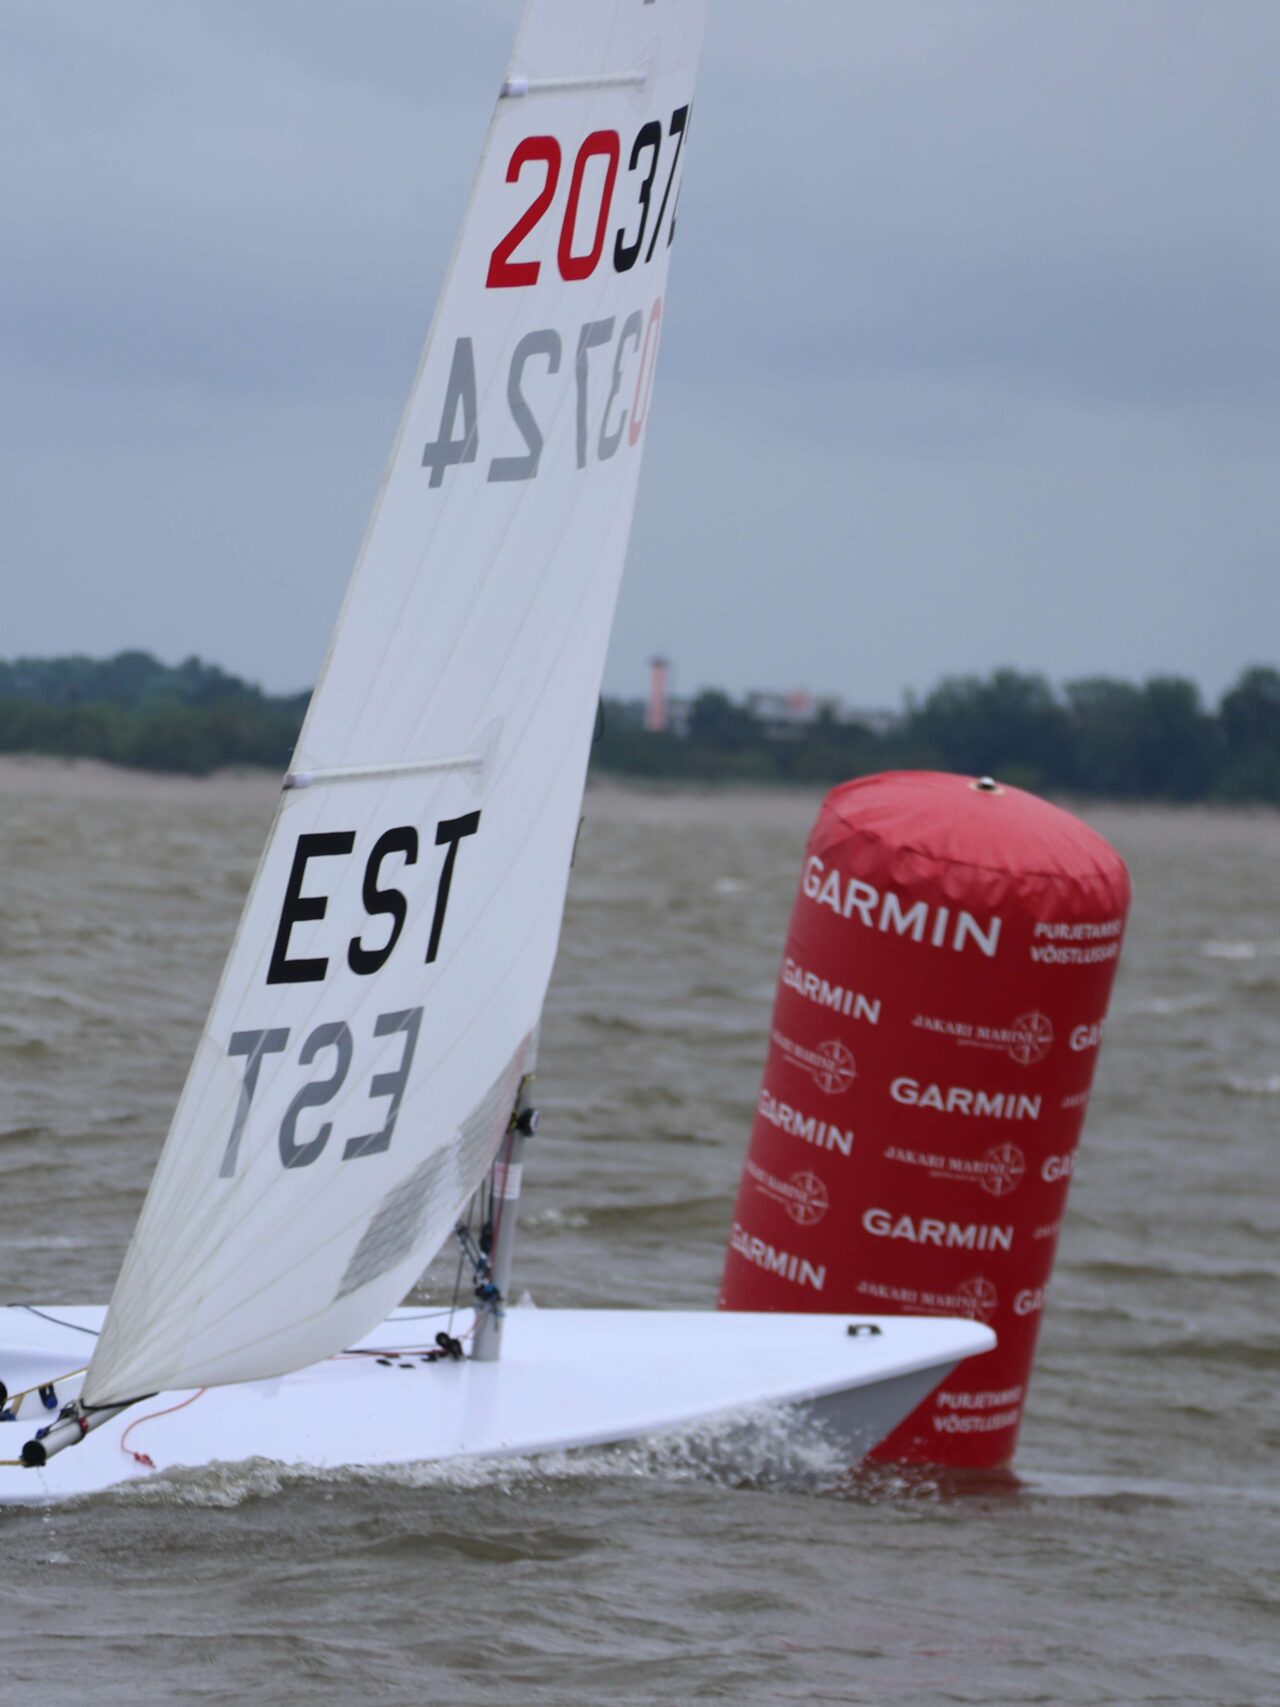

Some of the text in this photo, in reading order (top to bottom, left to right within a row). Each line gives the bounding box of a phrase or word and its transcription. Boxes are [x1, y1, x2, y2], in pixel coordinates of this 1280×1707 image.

[486, 104, 689, 288] 2037
[267, 810, 482, 984] EST
[802, 855, 1002, 957] GARMIN
[781, 957, 882, 1025] GARMIN
[759, 1089, 855, 1156] GARMIN
[889, 1075, 1042, 1120] GARMIN
[729, 1221, 826, 1291] GARMIN
[862, 1207, 1014, 1250] GARMIN
